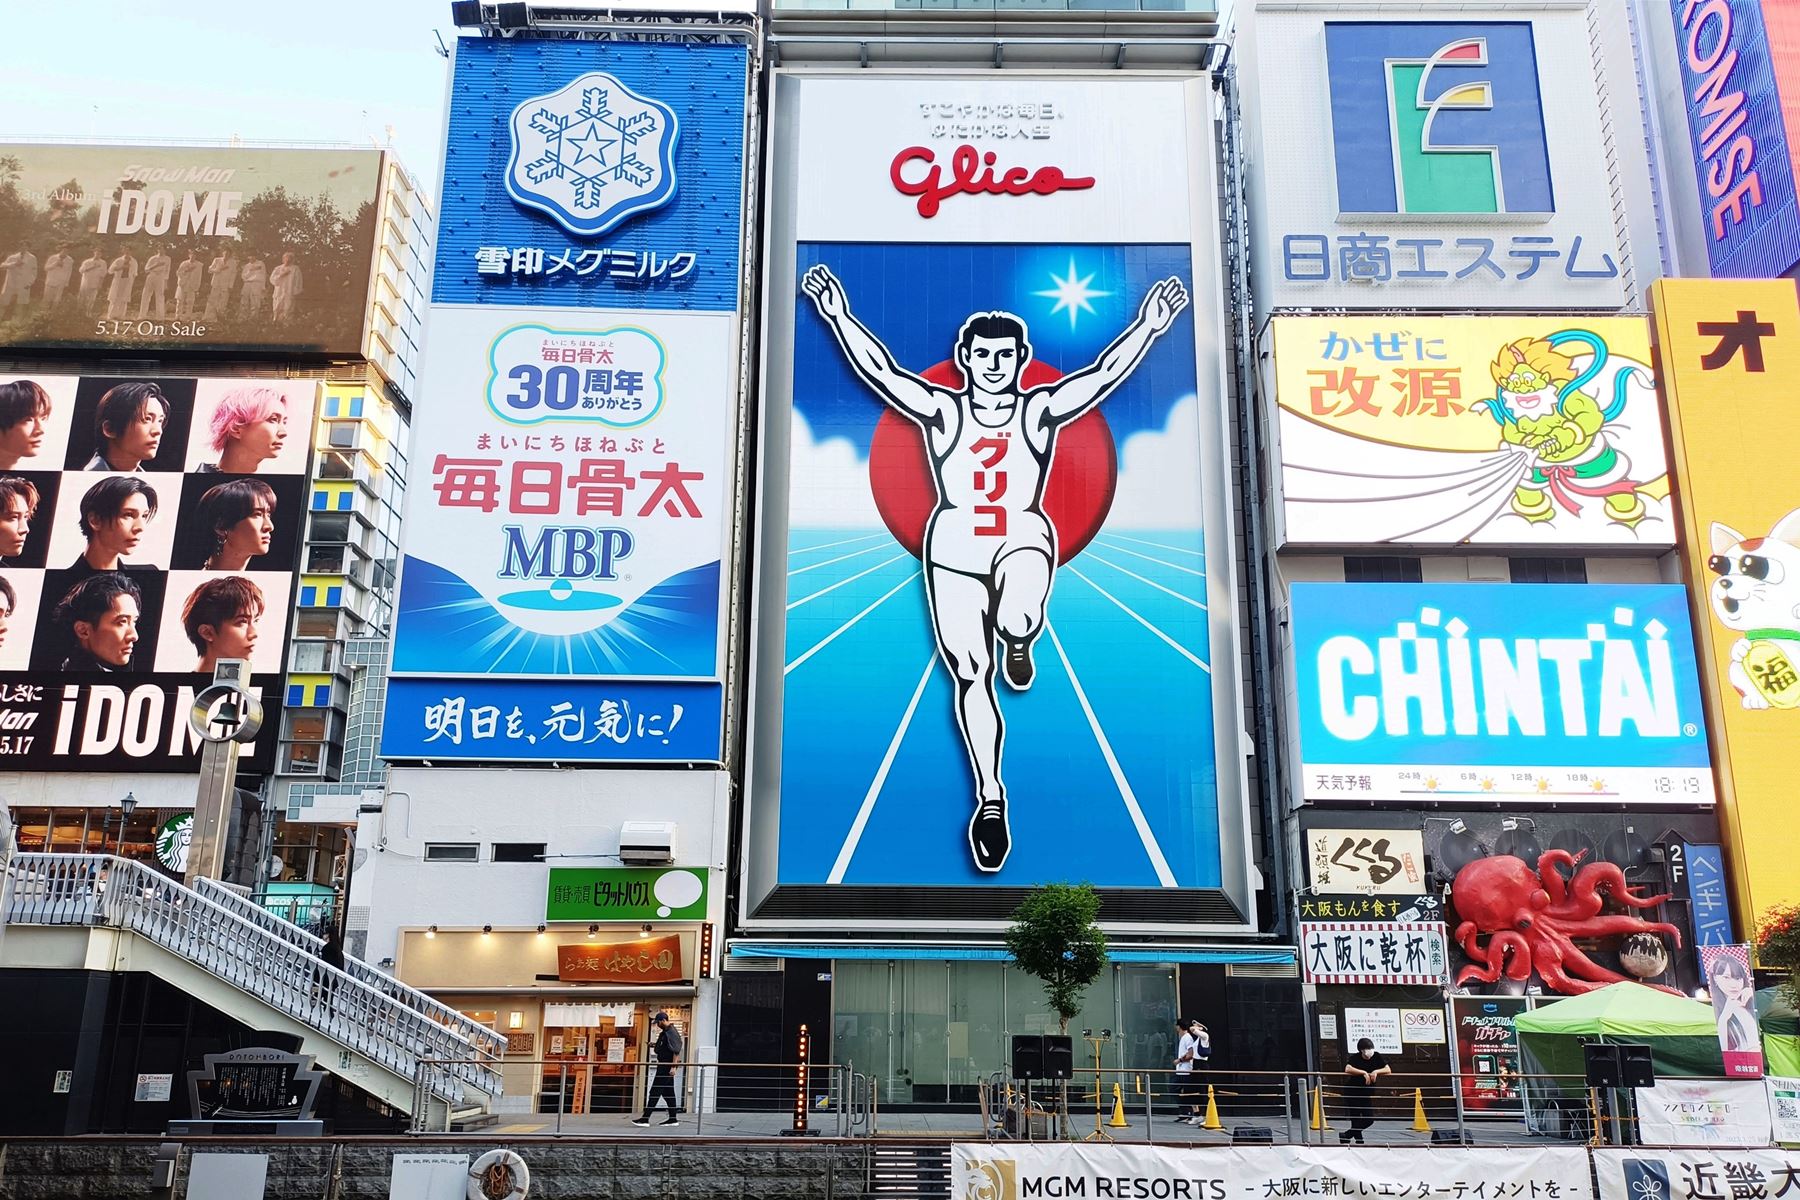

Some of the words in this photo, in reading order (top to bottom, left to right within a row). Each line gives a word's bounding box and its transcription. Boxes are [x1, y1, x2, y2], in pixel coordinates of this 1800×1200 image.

[931, 123, 1051, 140] ゆたかな人生
[1683, 0, 1763, 241] OMISE
[121, 164, 185, 183] Snow
[184, 165, 236, 184] Man
[890, 144, 1095, 218] Glico
[49, 188, 97, 201] Album
[475, 246, 697, 279] 雪印メグミルク
[1282, 231, 1619, 285] 日商エステム
[95, 320, 132, 336] 5.17
[137, 320, 165, 336] On
[170, 320, 206, 337] Sale
[1696, 310, 1776, 373] オ
[542, 338, 615, 348] まいにちほねぶと
[542, 347, 614, 365] 毎日骨太
[1320, 330, 1448, 361] かぜに
[581, 395, 643, 411] ありがとう
[1306, 366, 1466, 418] 改源
[476, 432, 666, 455] まいにちほねぶと
[432, 453, 704, 518] 毎日骨太
[968, 431, 1012, 536] グリコ
[496, 524, 635, 581] MBP
[1316, 606, 1681, 740] CHINTAI
[1759, 656, 1798, 694] 福
[0, 683, 43, 702] しさに
[1316, 774, 1372, 791] 天気予報
[1398, 772, 1421, 781] 24時
[1460, 772, 1477, 781] 6時
[1510, 773, 1532, 782] 12時
[1330, 837, 1402, 885] くくる
[593, 880, 651, 907] ピタットハウス
[1414, 896, 1438, 909] くくる
[1301, 899, 1401, 919] 大阪もんを食す
[1423, 910, 1440, 921] 2F
[1310, 932, 1427, 974] 大阪に乾杯
[1430, 938, 1442, 966] 検索
[1022, 1176, 1085, 1198] MGM
[1096, 1177, 1226, 1200] RESORTS
[1262, 1176, 1562, 1200] 大阪に新しいエンターテイメントを
[1680, 1160, 1800, 1200] 近畿大
